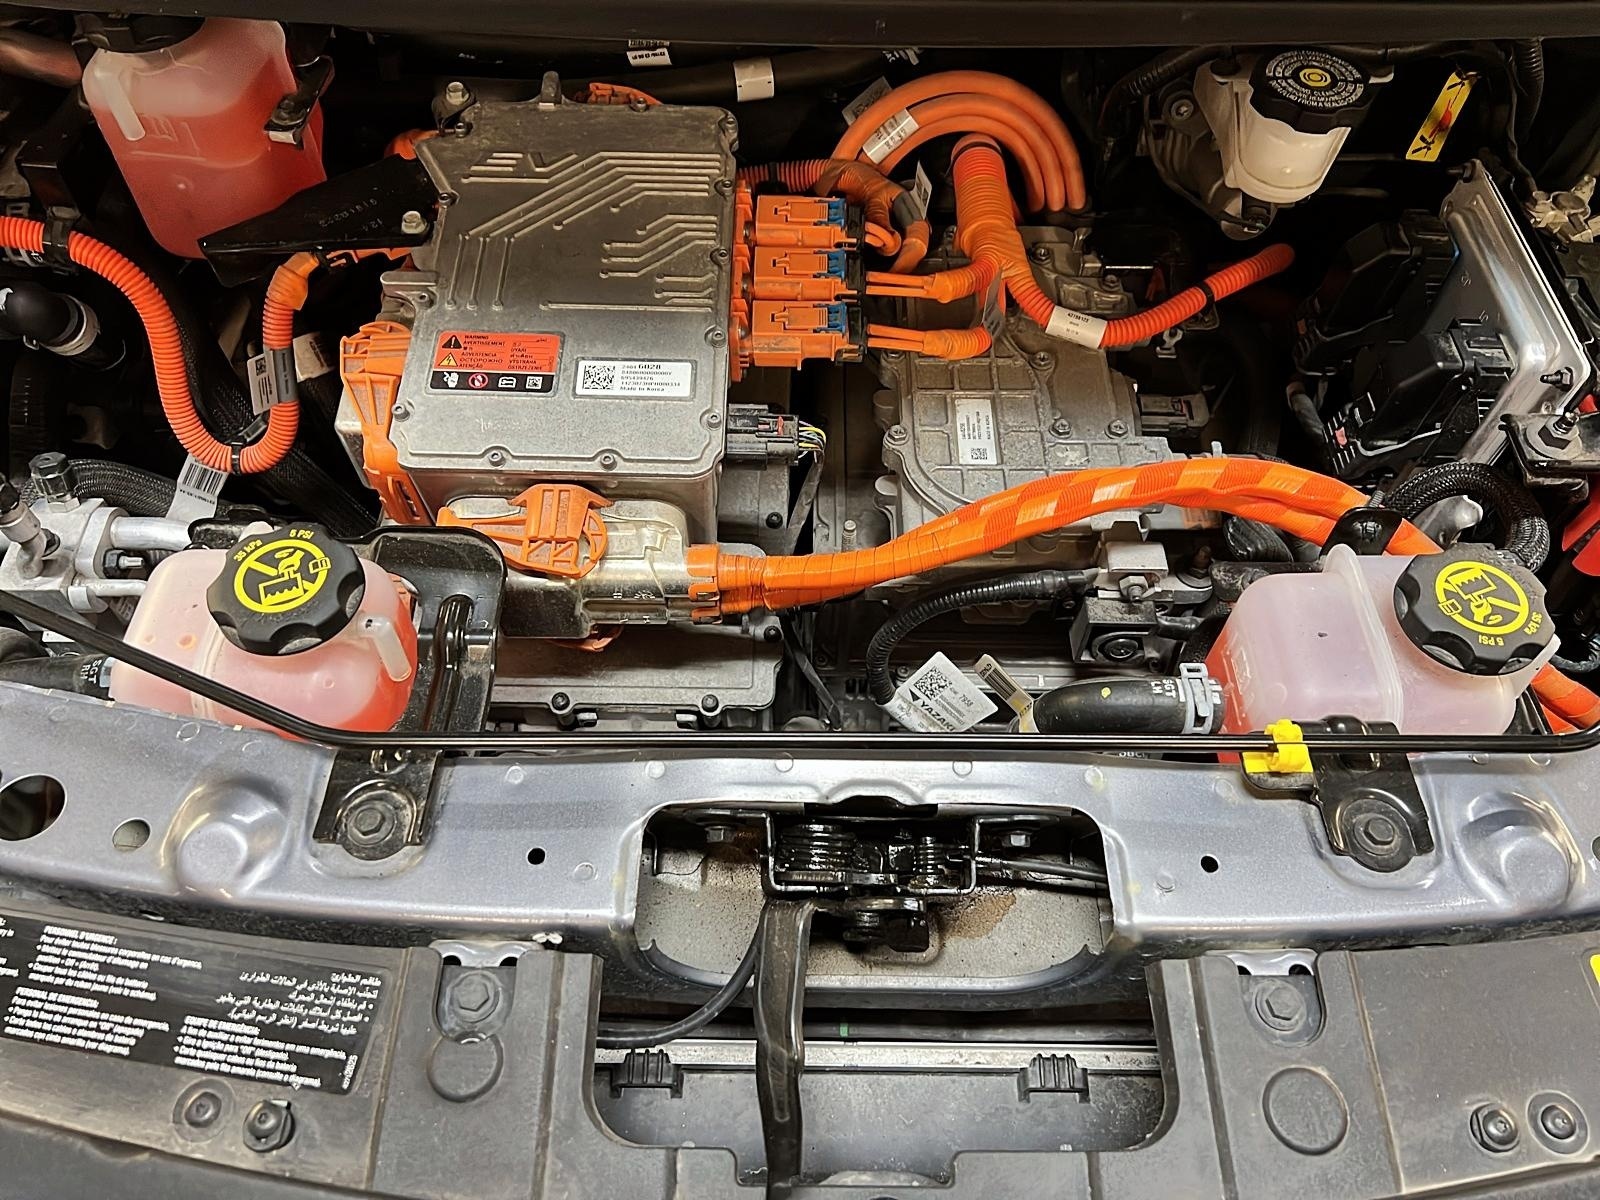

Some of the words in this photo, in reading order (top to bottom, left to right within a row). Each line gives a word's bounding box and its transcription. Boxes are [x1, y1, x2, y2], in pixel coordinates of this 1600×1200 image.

[297, 529, 314, 539] PSI
[234, 549, 247, 562] 35
[244, 538, 262, 553] kPa
[1532, 612, 1543, 624] 35
[1478, 635, 1496, 645] PSI
[81, 665, 92, 679] RH
[88, 660, 102, 684] SGT
[1151, 680, 1163, 694] LH
[920, 701, 956, 732] YAZAKI
